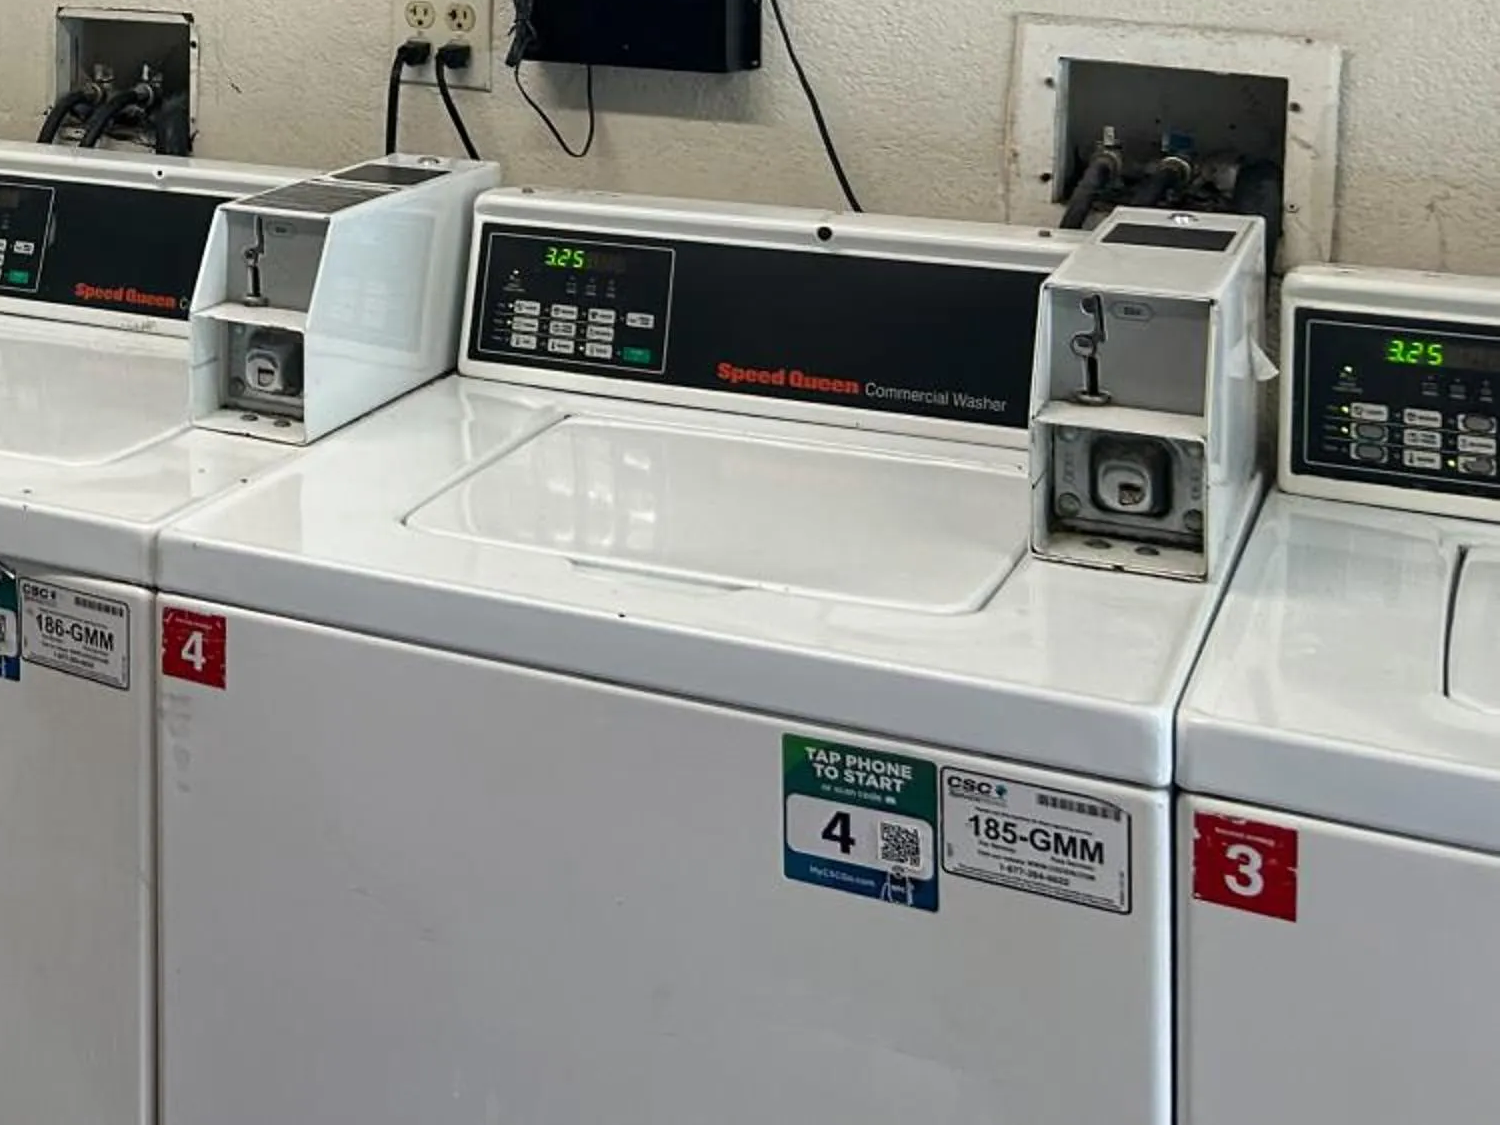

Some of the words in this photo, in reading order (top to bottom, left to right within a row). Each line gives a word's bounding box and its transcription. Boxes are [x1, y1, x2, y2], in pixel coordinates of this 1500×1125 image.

[74, 283, 124, 302] Speed
[125, 287, 177, 309] Queen
[716, 362, 785, 387] Speed
[789, 370, 860, 395] Queen
[865, 382, 950, 406] Commercial
[952, 392, 1007, 413] Washer
[36, 613, 115, 652] 186-GMM
[181, 630, 207, 672] 4
[805, 746, 841, 764] TAP
[846, 754, 912, 780] PHONE
[813, 762, 839, 779] TO
[843, 769, 905, 793] START
[947, 775, 992, 795] CSC
[821, 811, 856, 855] 4
[967, 814, 1105, 865] 185-GMM
[1223, 843, 1264, 897] 3
